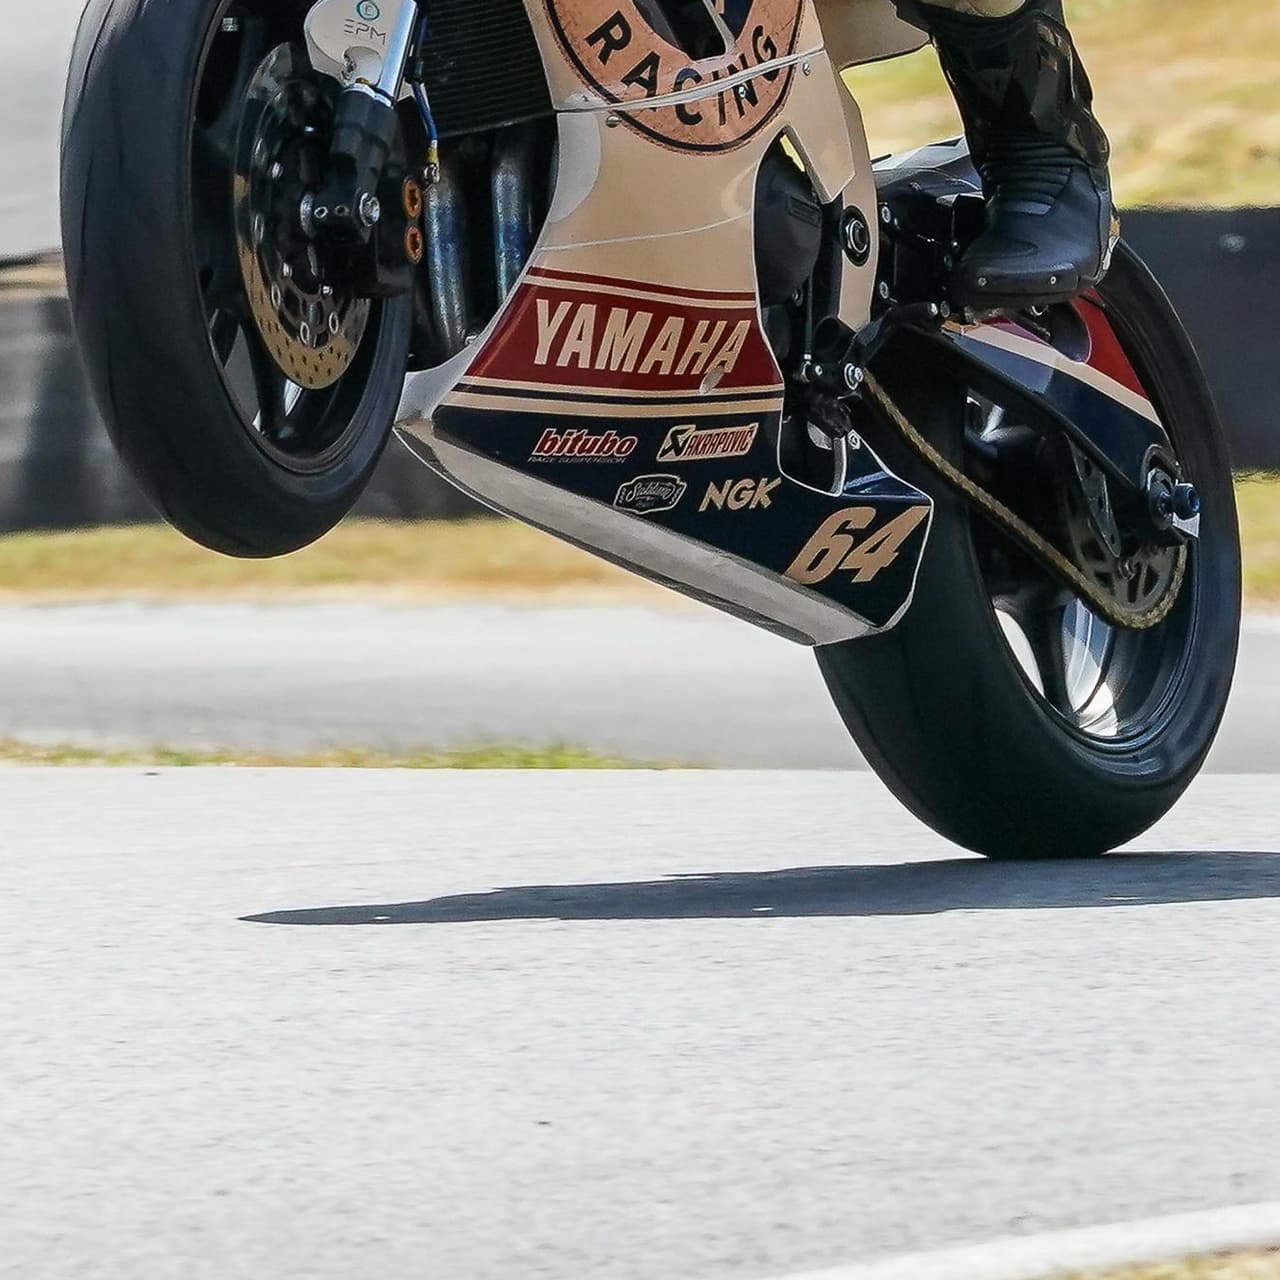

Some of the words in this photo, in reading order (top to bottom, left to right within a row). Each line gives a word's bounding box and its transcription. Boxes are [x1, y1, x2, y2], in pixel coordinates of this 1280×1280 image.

[585, 10, 780, 126] RACING
[534, 299, 752, 376] YAMAHA
[532, 428, 639, 456] bitubo
[698, 476, 782, 513] NGK
[783, 505, 931, 585] 64
